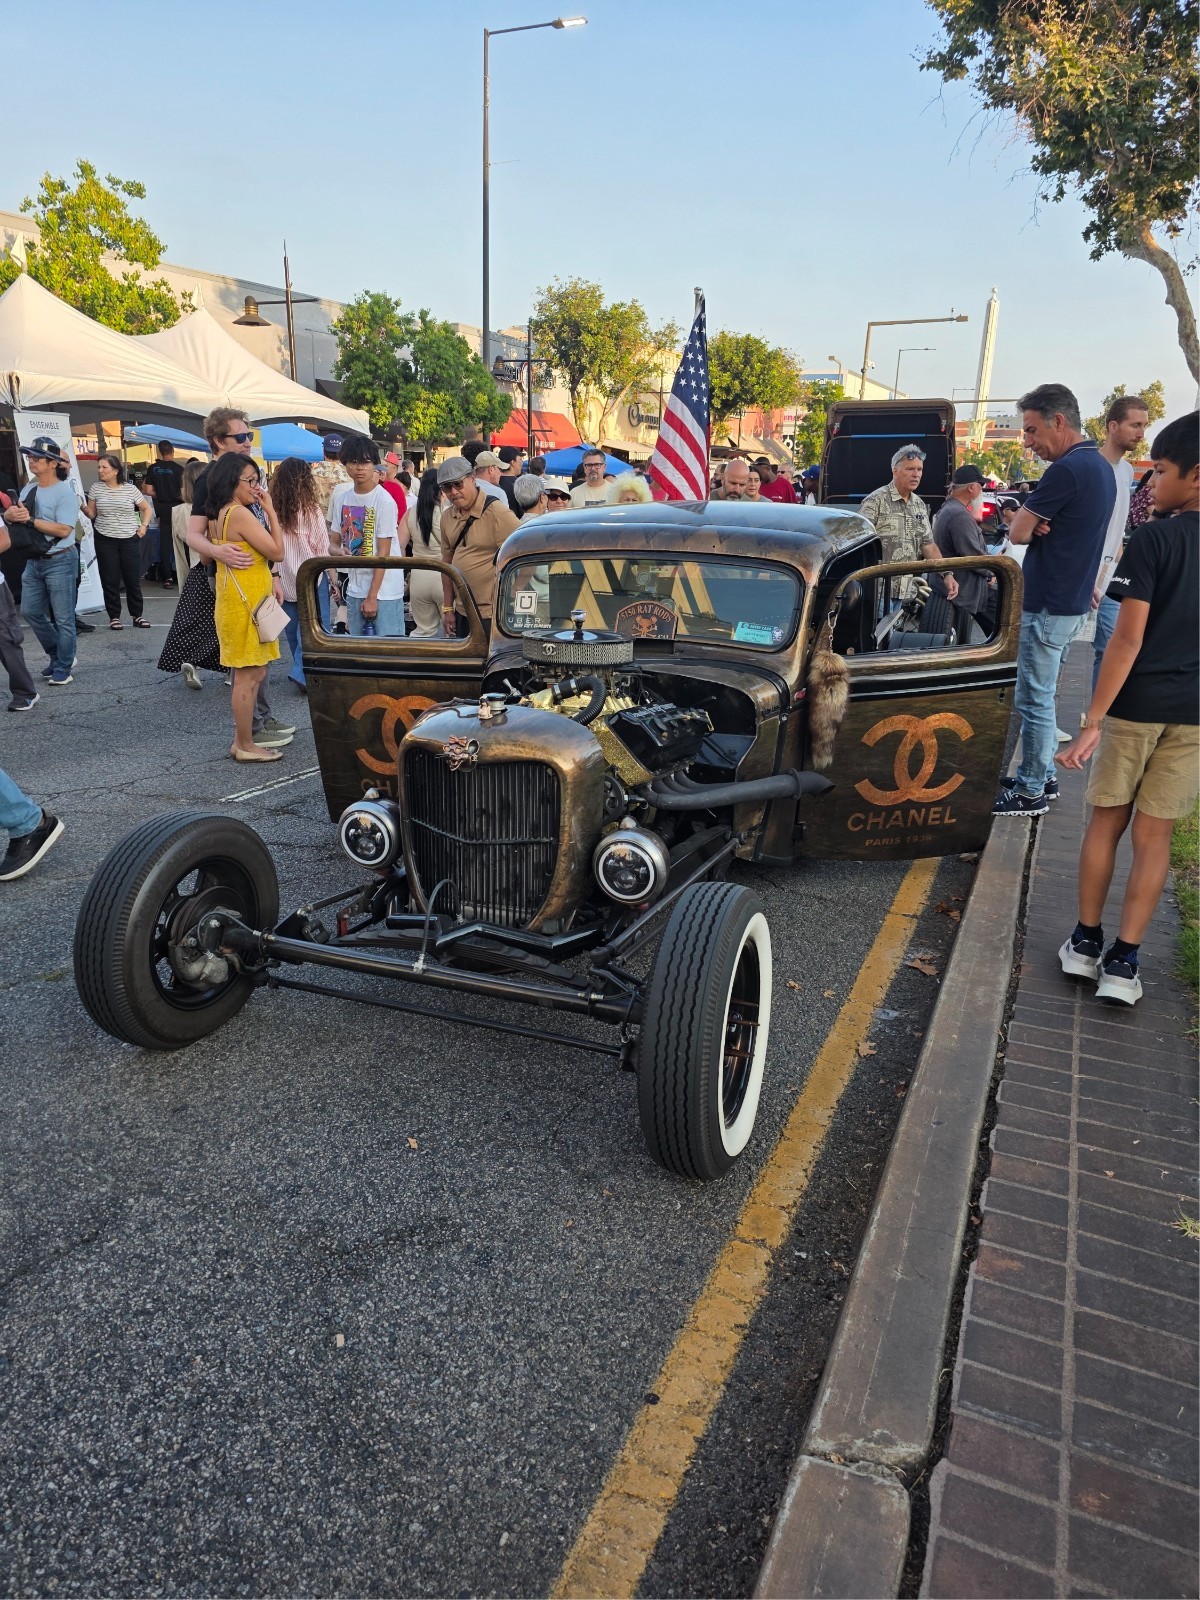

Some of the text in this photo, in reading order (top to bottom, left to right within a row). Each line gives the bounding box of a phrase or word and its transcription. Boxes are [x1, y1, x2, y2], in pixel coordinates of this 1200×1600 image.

[29, 420, 60, 430] ENSEMBLE
[637, 604, 653, 614] RAT
[653, 605, 674, 623] RODS
[507, 616, 541, 624] UBER
[847, 806, 957, 832] CHANEL
[865, 836, 902, 847] PARIS
